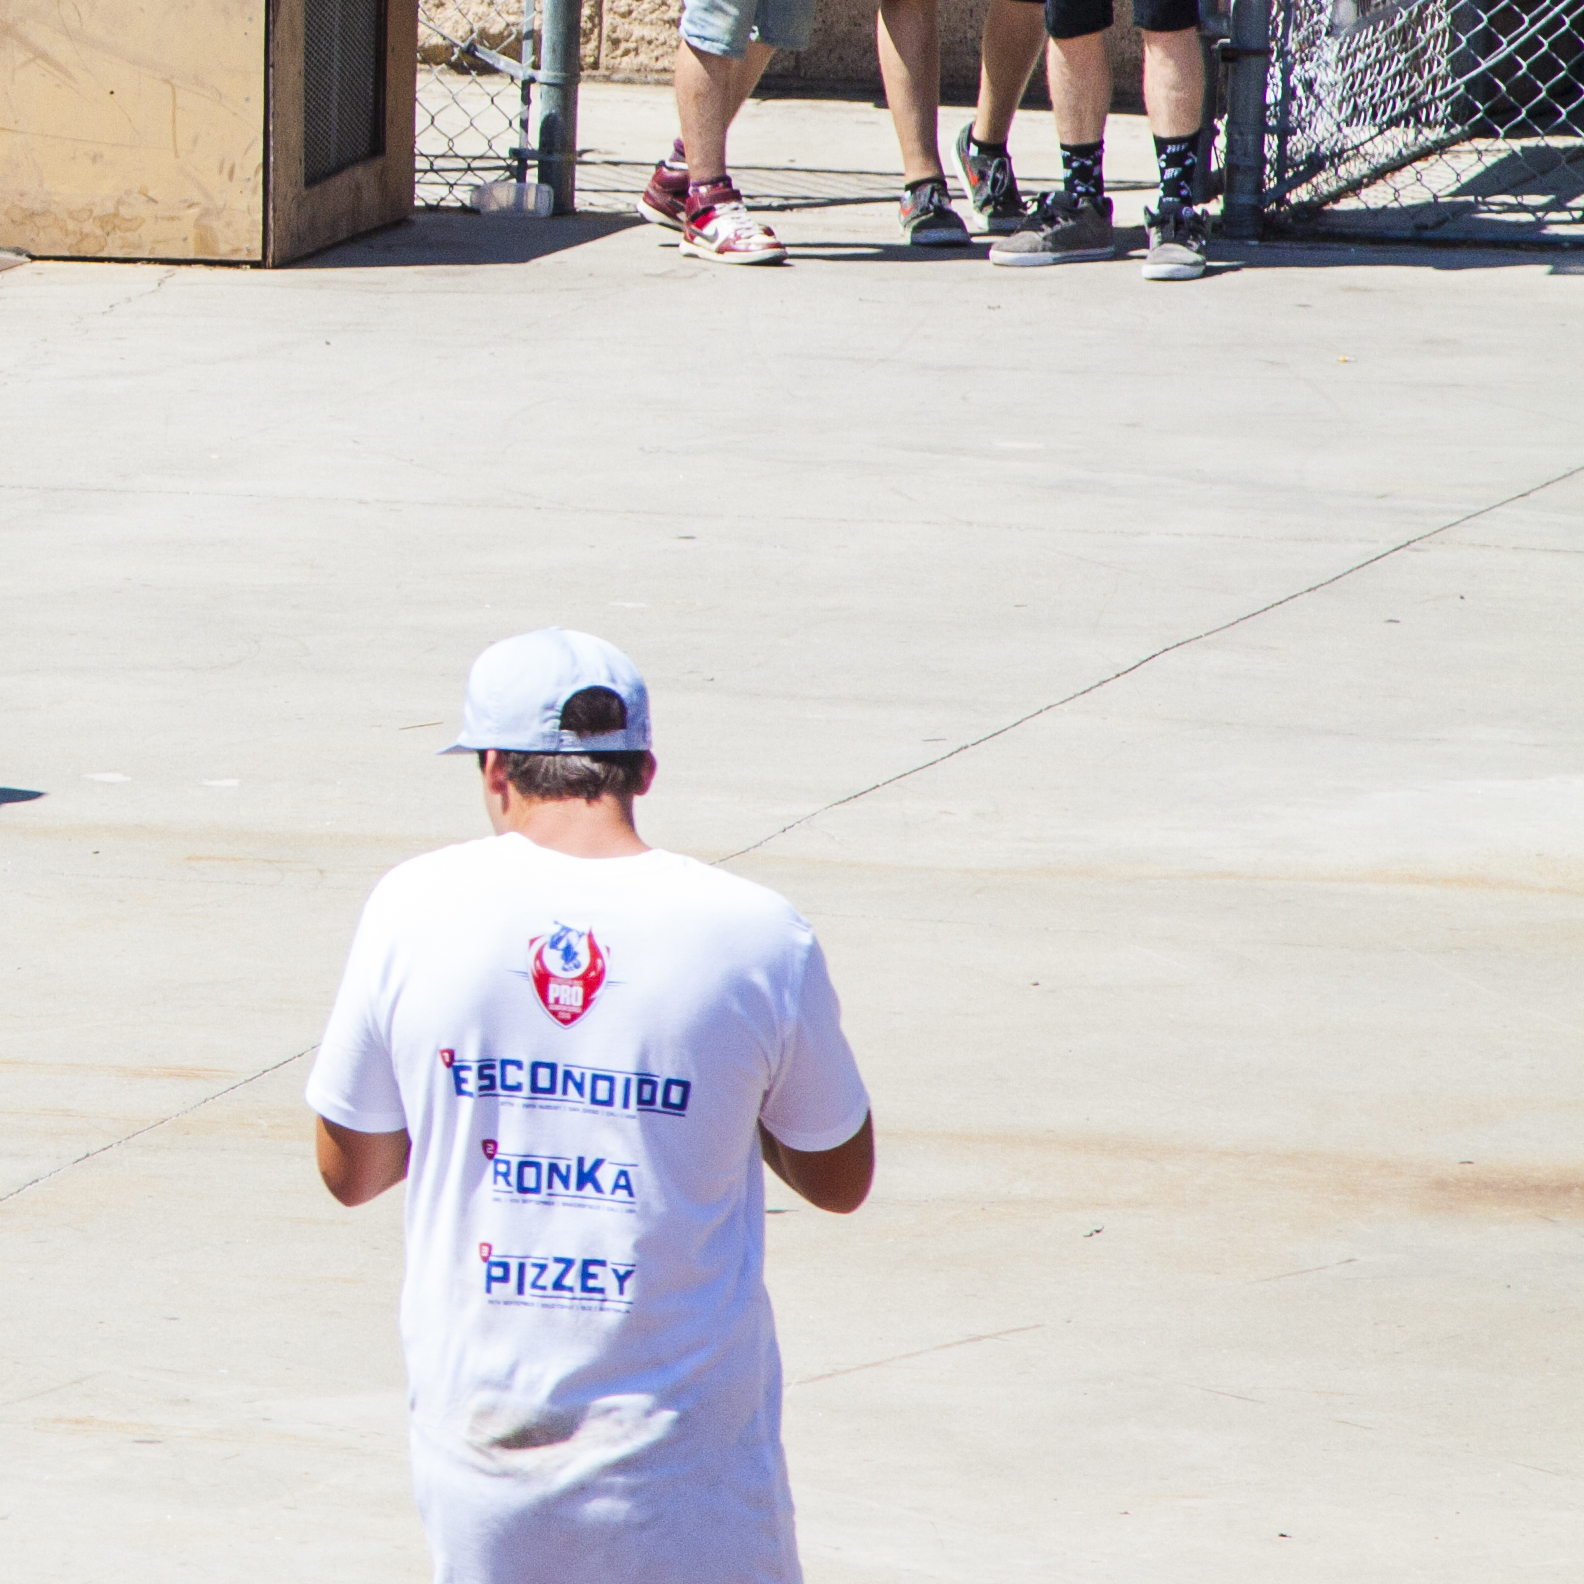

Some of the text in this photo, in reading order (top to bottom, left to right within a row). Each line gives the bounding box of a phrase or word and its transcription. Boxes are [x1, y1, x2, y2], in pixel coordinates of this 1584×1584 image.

[548, 983, 584, 1007] PRO
[452, 1058, 691, 1111] ESCONDIDO
[485, 1256, 636, 1296] PIZZEY
